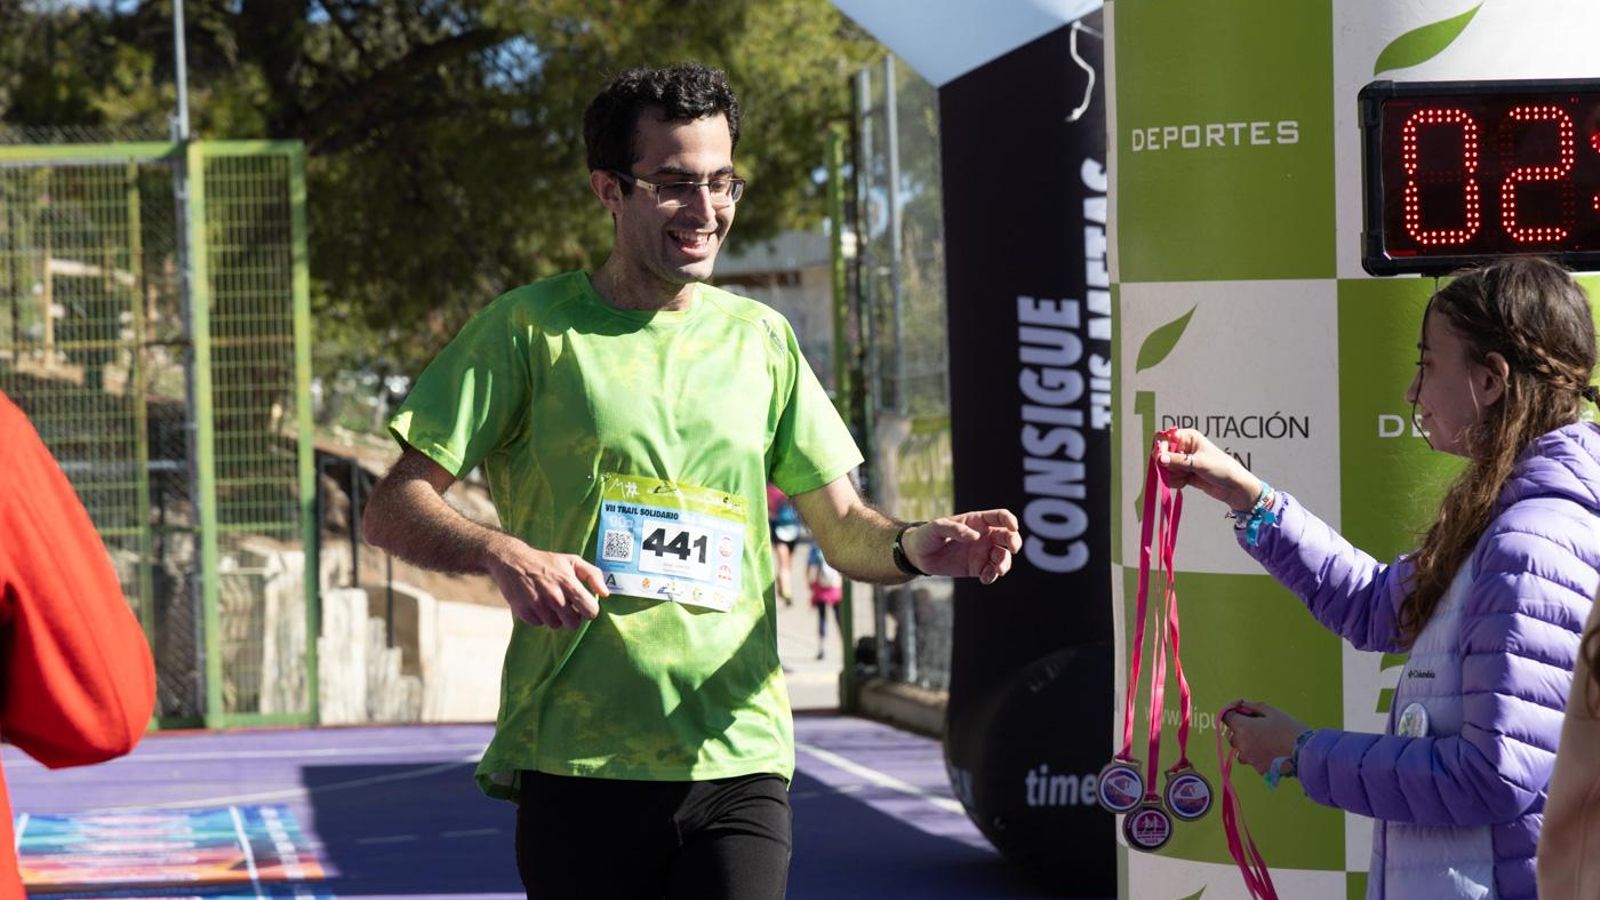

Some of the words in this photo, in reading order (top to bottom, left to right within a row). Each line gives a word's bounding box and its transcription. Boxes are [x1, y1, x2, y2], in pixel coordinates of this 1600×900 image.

[1131, 120, 1300, 152] DEPORTES
[1017, 296, 1089, 572] CONSIGUE
[616, 505, 639, 516] TRAIL
[639, 508, 679, 521] SOLIDARIO
[642, 527, 708, 564] 441
